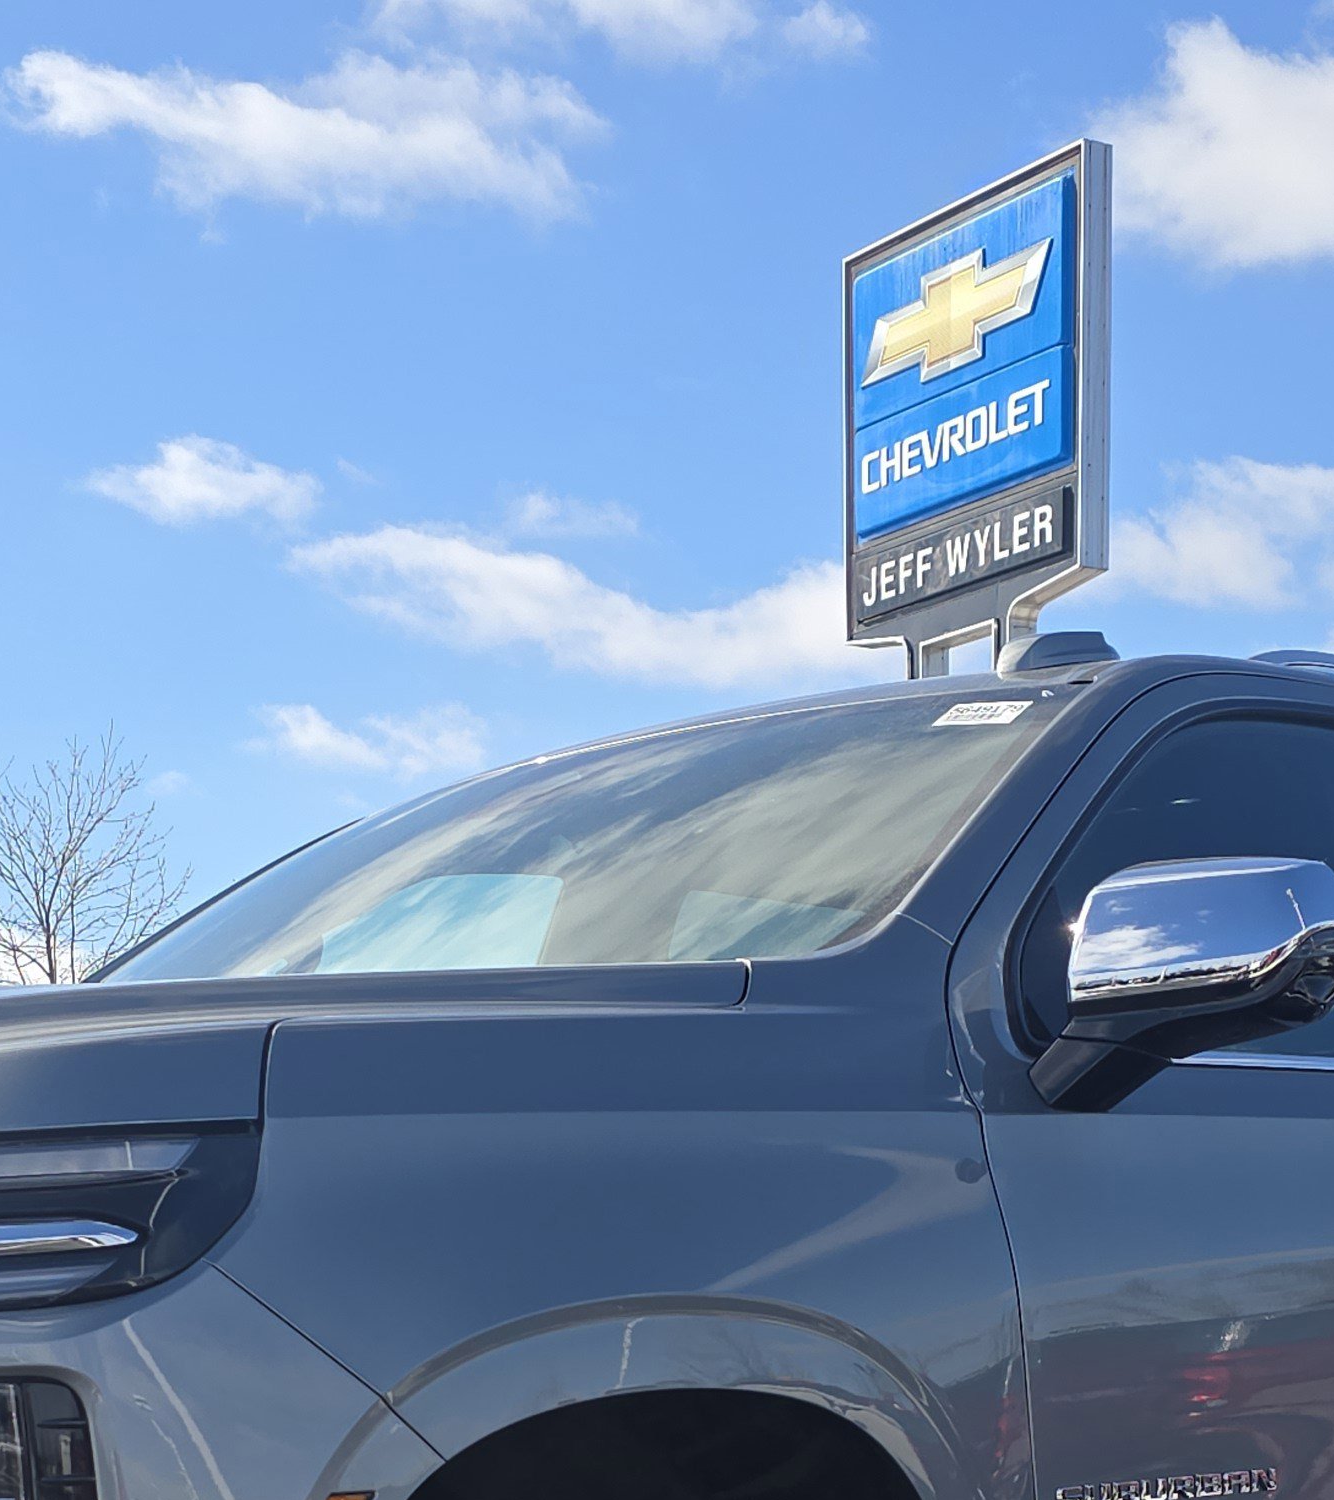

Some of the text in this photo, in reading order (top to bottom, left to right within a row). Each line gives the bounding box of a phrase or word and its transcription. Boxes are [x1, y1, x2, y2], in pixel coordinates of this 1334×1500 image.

[861, 379, 1050, 494] CHEVROLET
[863, 504, 1053, 606] JEFF WYLER
